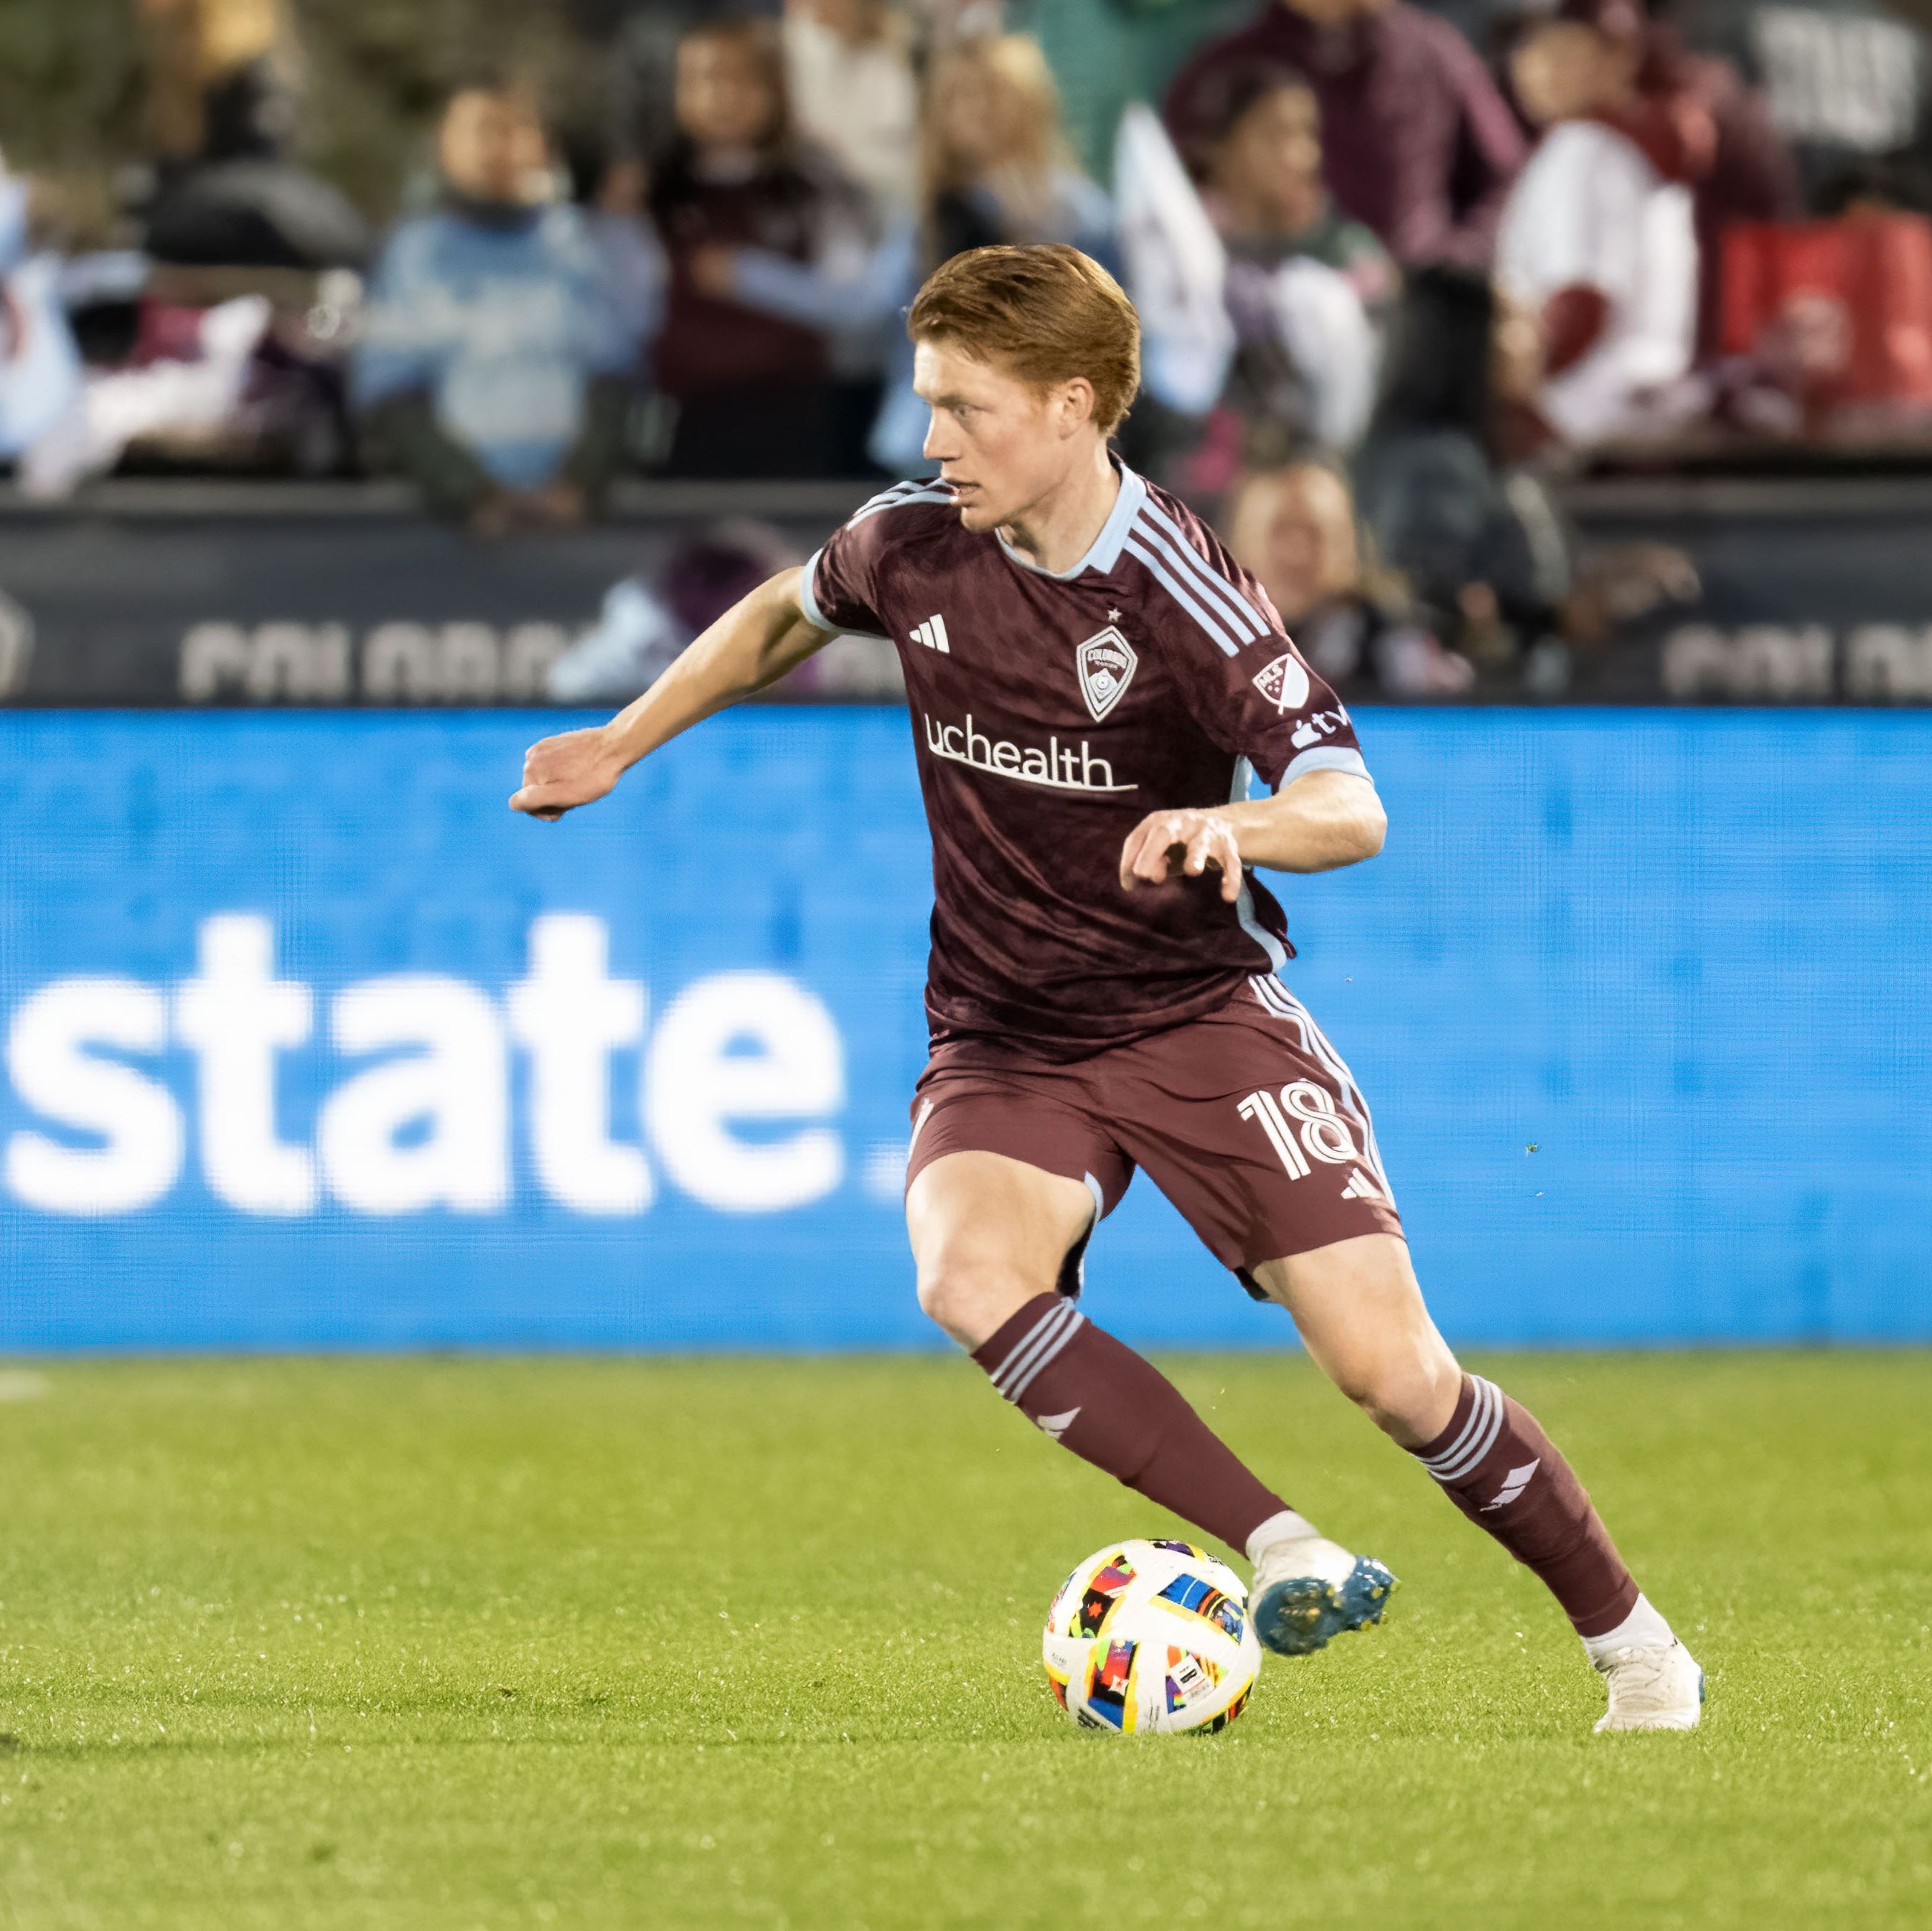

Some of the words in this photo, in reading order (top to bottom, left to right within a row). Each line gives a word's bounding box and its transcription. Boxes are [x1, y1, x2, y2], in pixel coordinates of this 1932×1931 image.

[1257, 664, 1284, 689] MLS
[924, 713, 1120, 791] uchealth
[1237, 1078, 1359, 1182] 18
